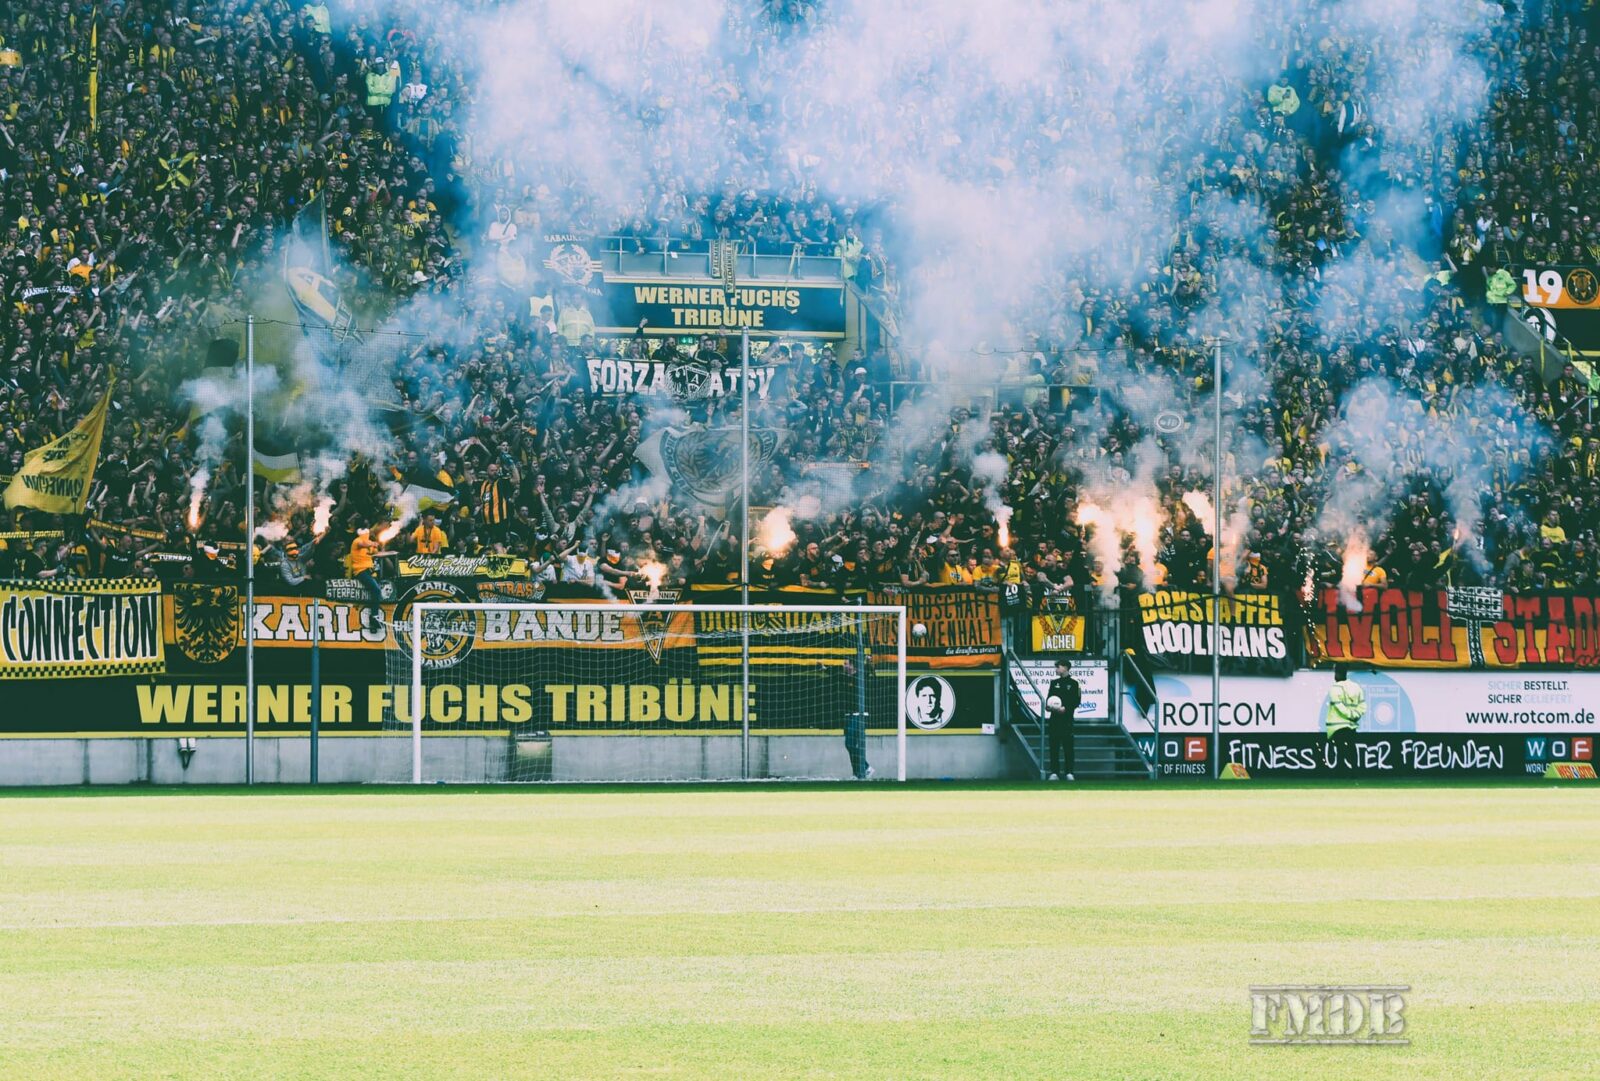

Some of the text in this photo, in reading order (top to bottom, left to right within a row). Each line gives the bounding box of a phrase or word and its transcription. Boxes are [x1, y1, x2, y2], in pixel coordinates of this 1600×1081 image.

[634, 286, 801, 308] WERNER FUCHS
[1523, 269, 1563, 304] 19
[671, 305, 764, 327] TRIBÜNE
[587, 358, 776, 400] FORZA ATSV
[407, 554, 488, 568] Keine Sekunde
[414, 581, 458, 596] KARLS
[2, 592, 158, 662] CONNECTION
[243, 603, 624, 642] KARLS BANDE
[1494, 593, 1600, 666] STAD
[1142, 621, 1287, 659] HOOLIGANS
[1523, 680, 1570, 691] BESTELLT.
[137, 677, 757, 723] WERNER FUCHS TRIBÜNE
[1488, 694, 1522, 704] SICHER
[1162, 702, 1276, 726] ROTCOM
[1465, 708, 1595, 724] www.rotcom.de
[1229, 740, 1317, 769] FITNESS
[1401, 739, 1503, 769] FREUNDEN
[1164, 764, 1206, 775] OF FITNESS
